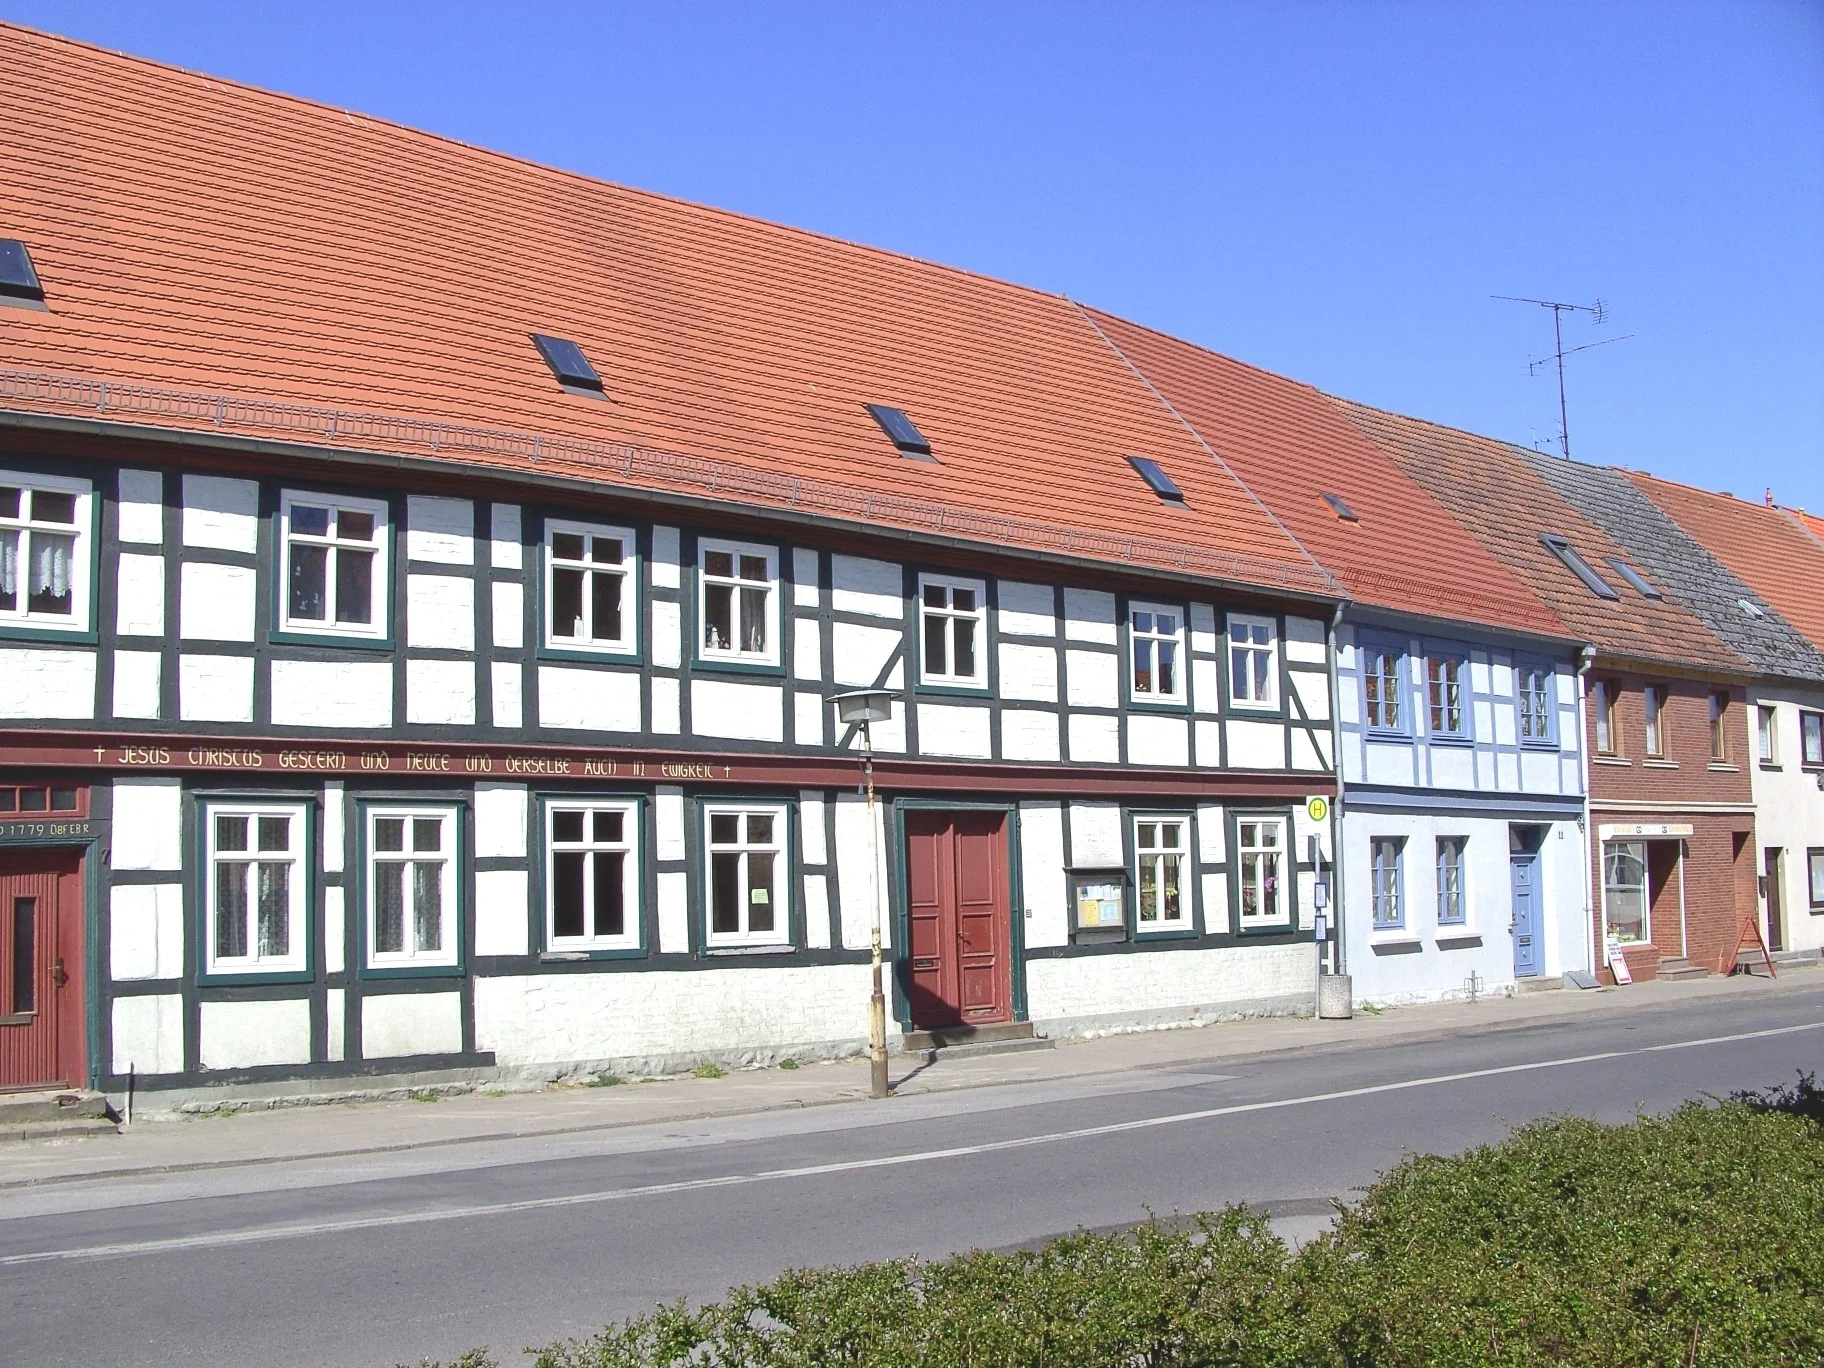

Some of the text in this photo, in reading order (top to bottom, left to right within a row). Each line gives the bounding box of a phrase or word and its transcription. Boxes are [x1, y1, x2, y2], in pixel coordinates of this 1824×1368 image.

[118, 745, 170, 765] JESUS
[278, 750, 346, 769] GESTERN
[10, 824, 44, 836] 1779
